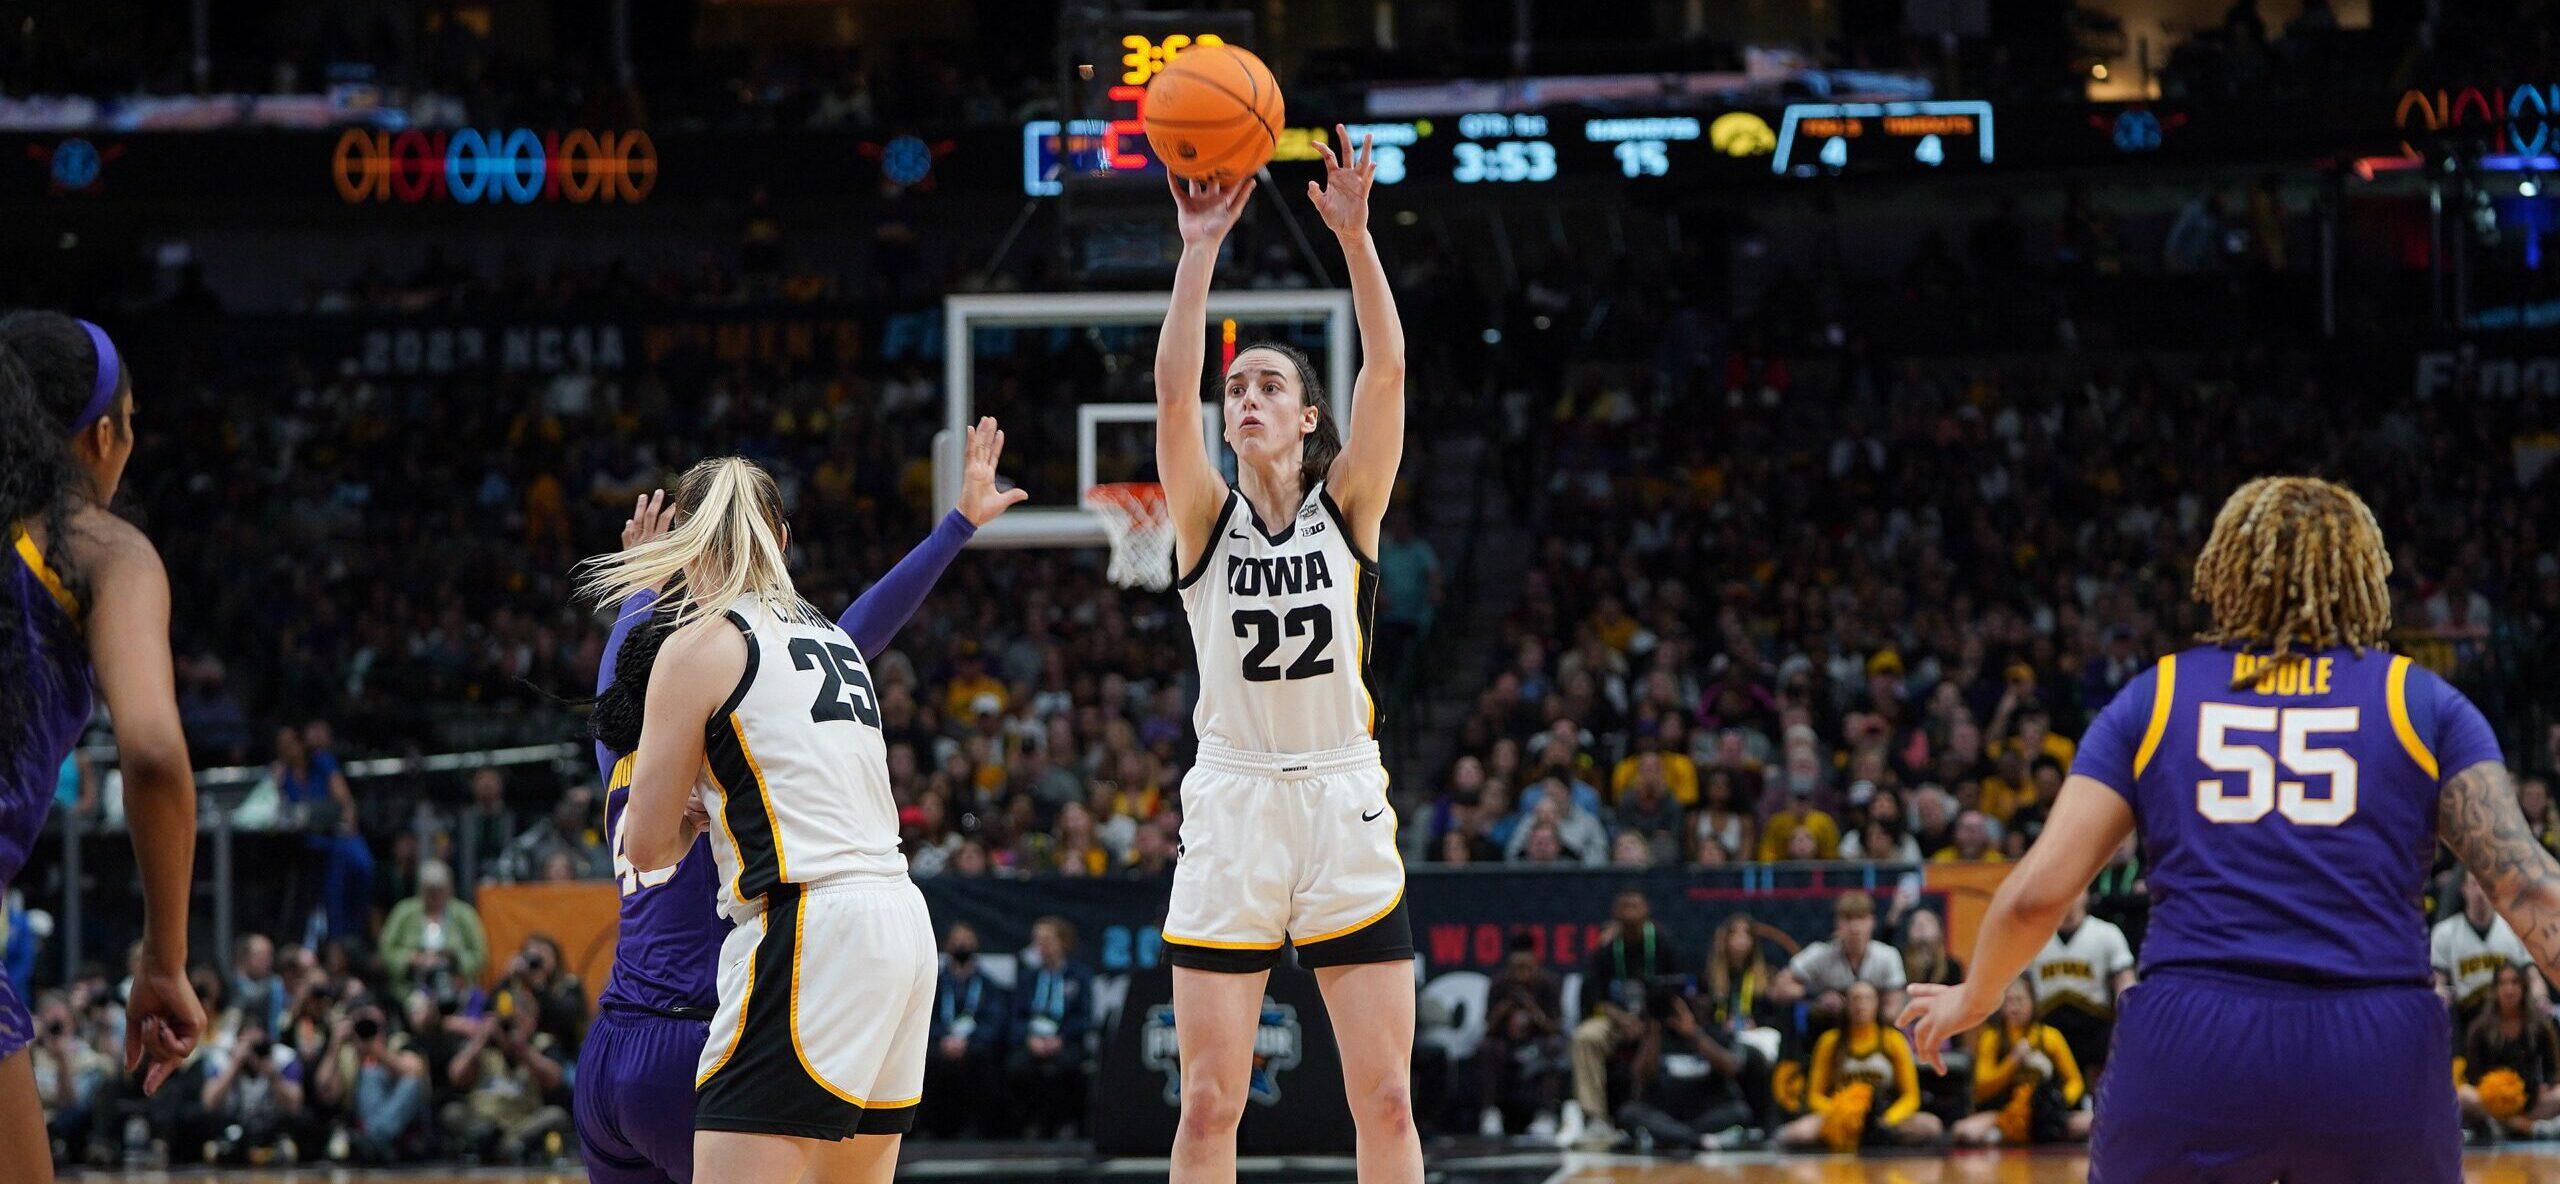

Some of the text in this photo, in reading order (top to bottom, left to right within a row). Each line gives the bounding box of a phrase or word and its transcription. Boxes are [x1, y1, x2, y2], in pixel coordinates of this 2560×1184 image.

[1454, 142, 1557, 183] 3:53
[1614, 139, 1669, 178] 15
[1820, 134, 1944, 166] 4 4
[1228, 551, 1333, 597] IOWA
[1232, 603, 1334, 682] 22
[788, 637, 882, 730] 25
[2196, 701, 2360, 827] 55
